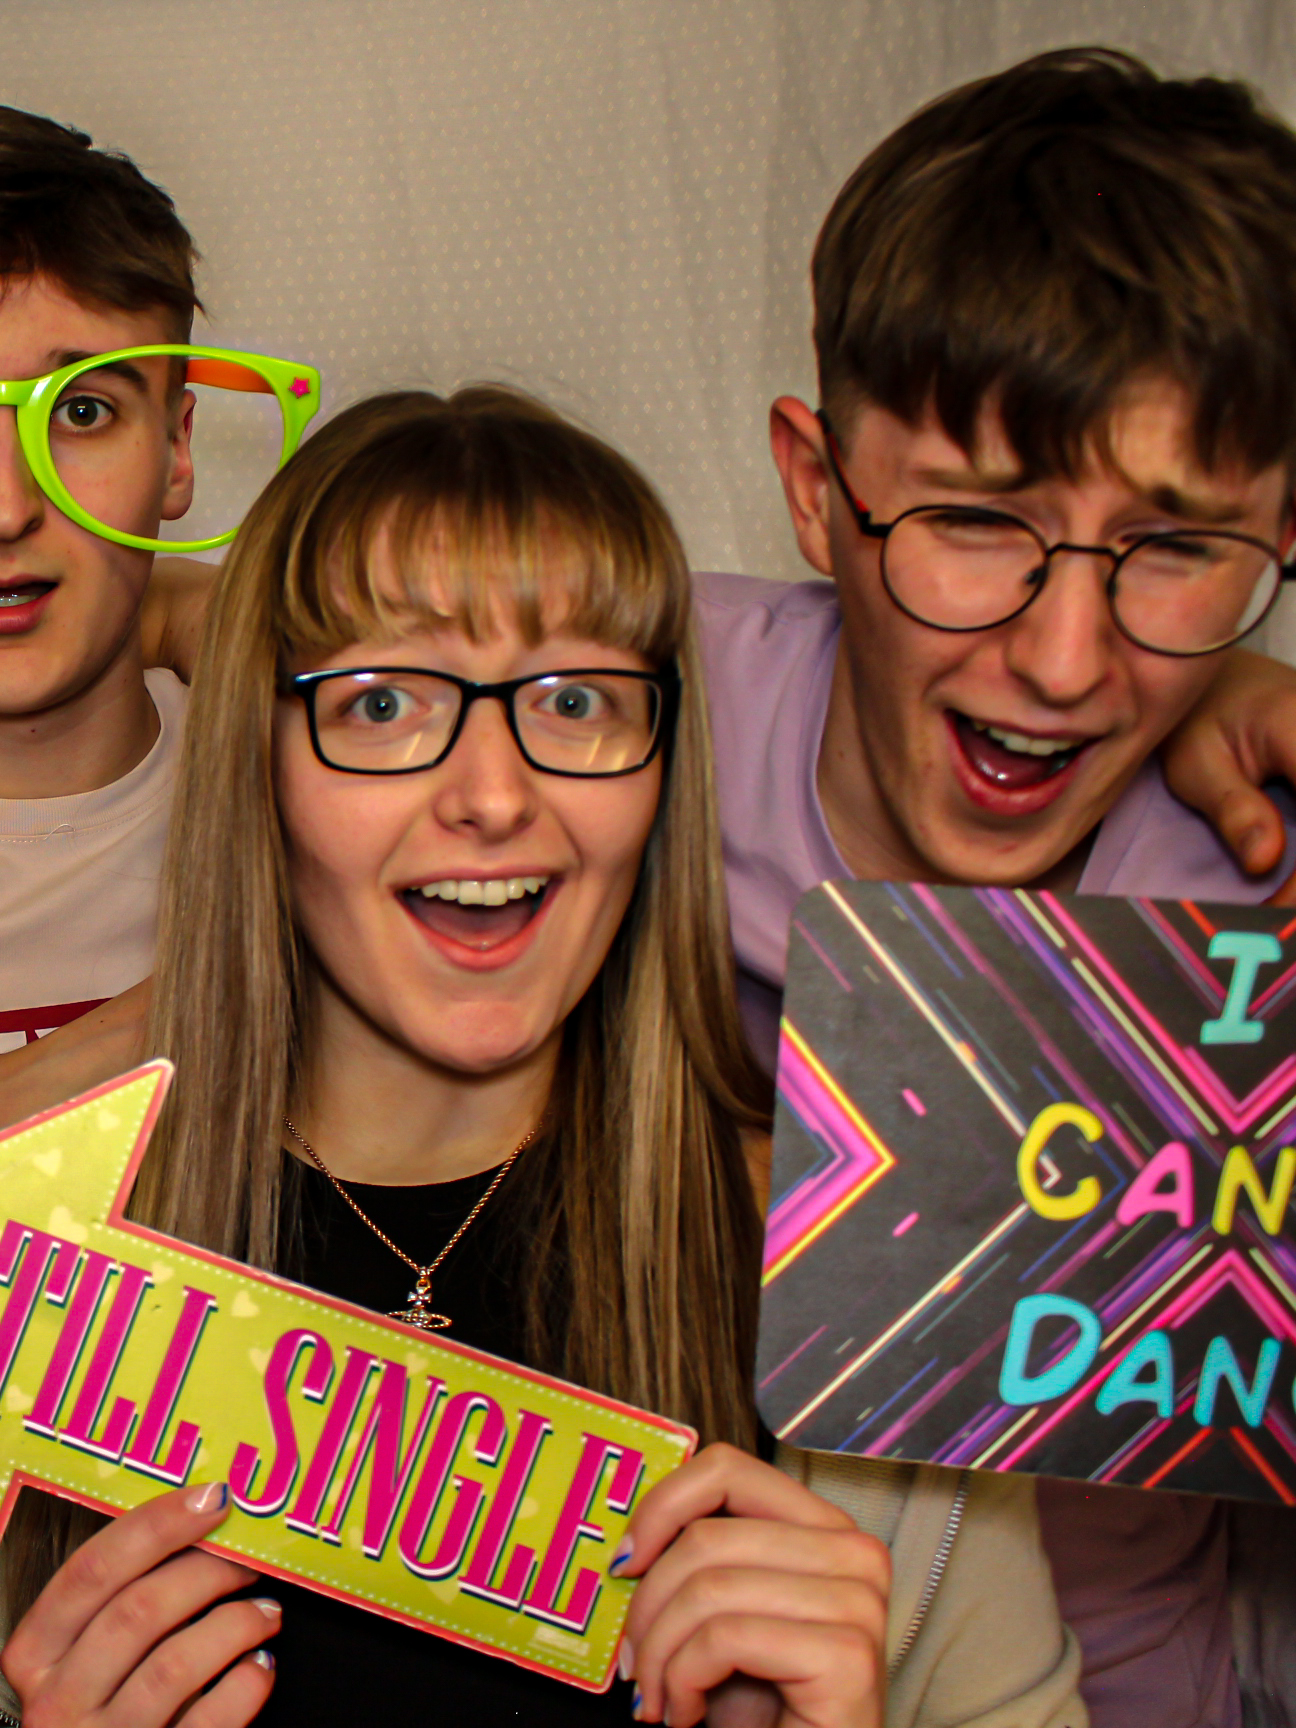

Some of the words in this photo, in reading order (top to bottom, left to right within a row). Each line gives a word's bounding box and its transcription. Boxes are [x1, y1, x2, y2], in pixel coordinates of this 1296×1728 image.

[1200, 931, 1283, 1044] I
[1016, 1103, 1296, 1236] CAN
[998, 1293, 1296, 1427] DAN
[229, 1329, 646, 1633] SINGLE
